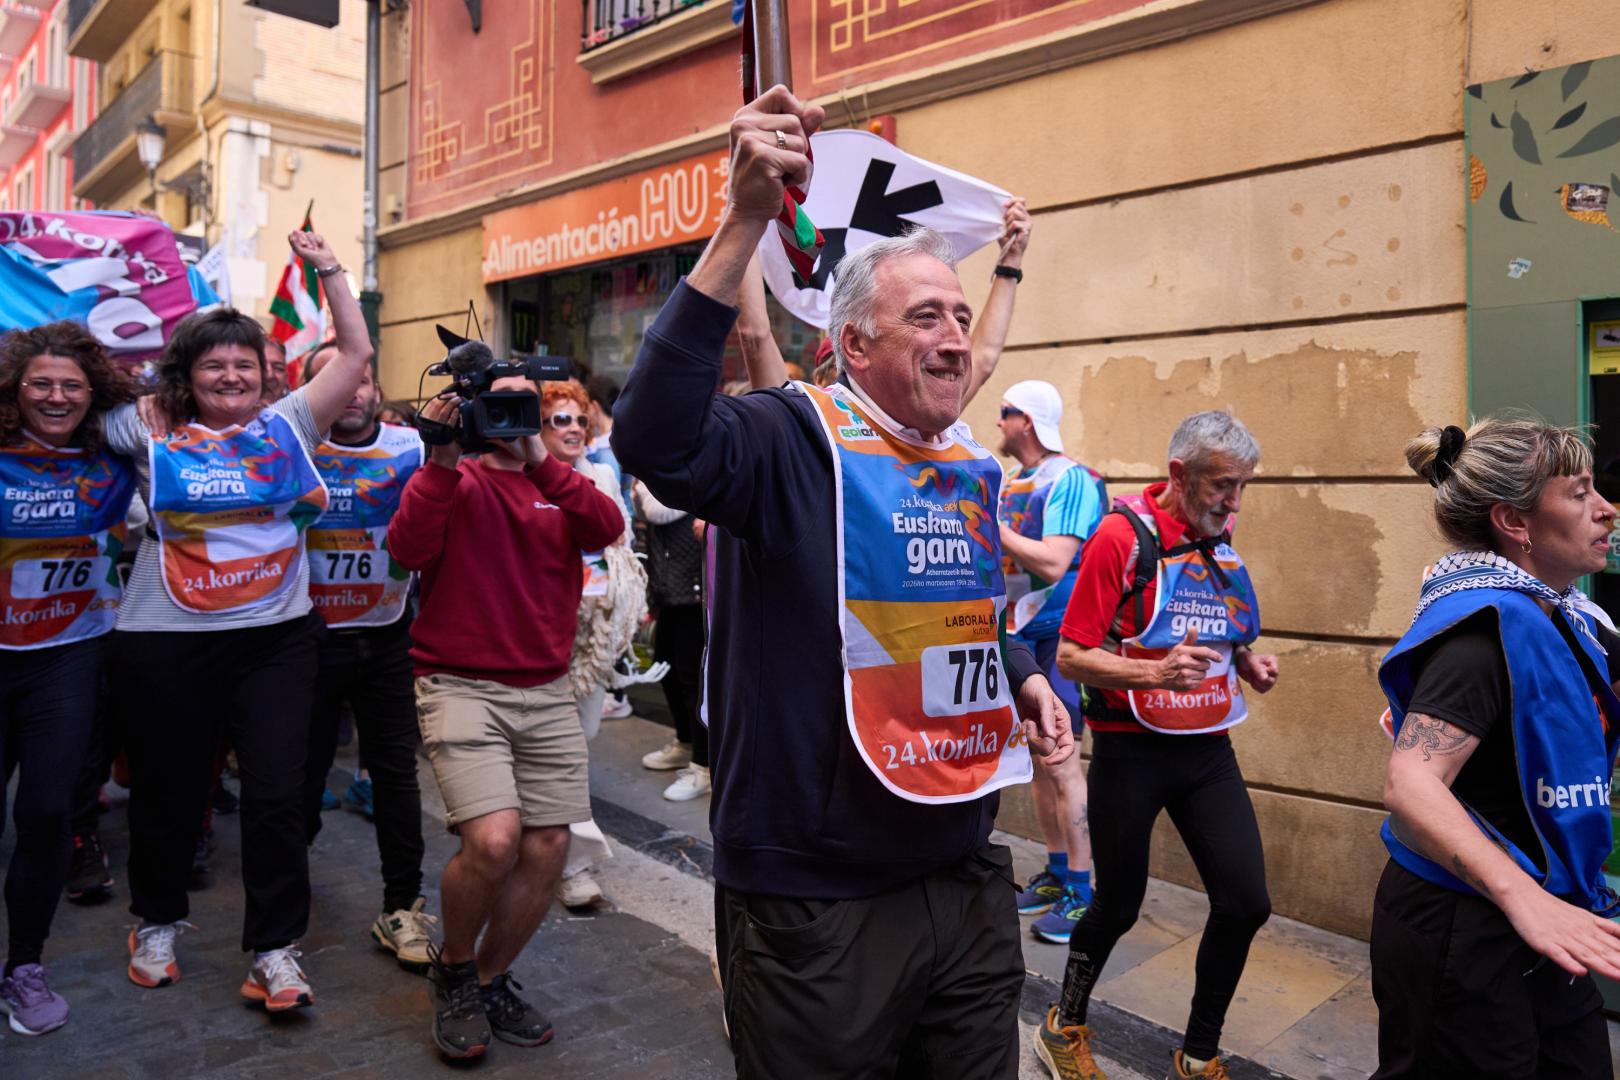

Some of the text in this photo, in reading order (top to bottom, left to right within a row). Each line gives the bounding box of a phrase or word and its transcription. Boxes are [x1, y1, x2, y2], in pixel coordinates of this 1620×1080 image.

[482, 207, 639, 275] Alimentación
[641, 163, 708, 242] HU
[5, 488, 74, 501] Euskara
[187, 480, 246, 501] gara
[12, 501, 76, 523] gara
[892, 512, 964, 536] Euskara
[325, 552, 372, 579] 776
[906, 537, 971, 574] gara
[41, 561, 92, 592] 776
[183, 562, 283, 592] 24.korrika
[1166, 600, 1228, 617] Euskara
[944, 614, 989, 628] LABORAL
[1170, 615, 1228, 637] gara
[948, 647, 999, 705] 776
